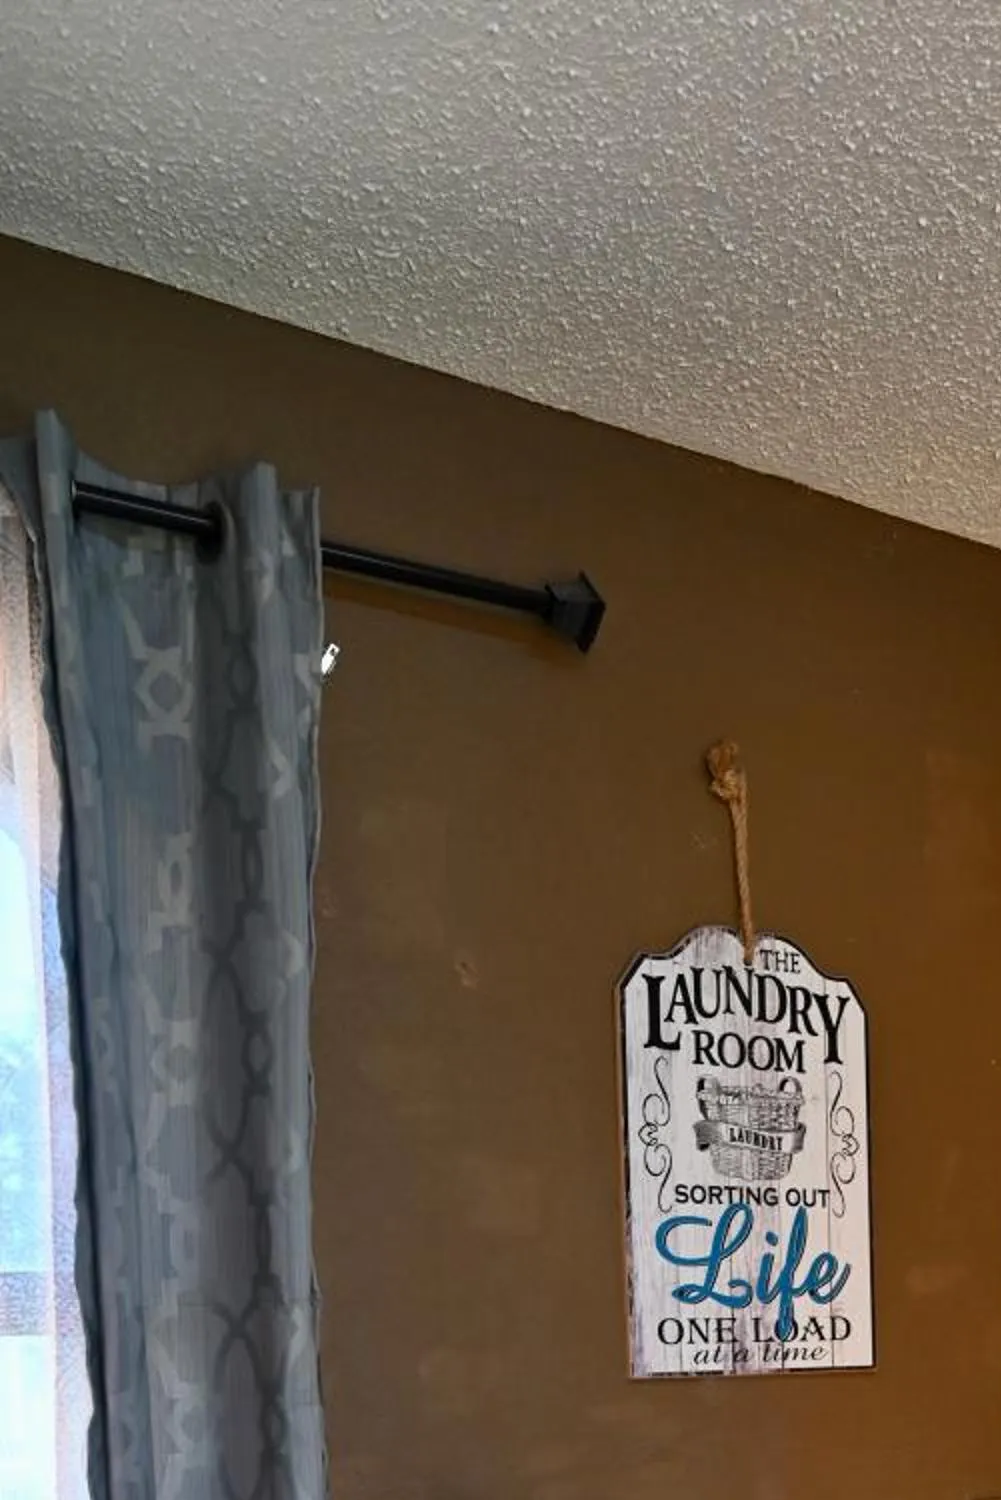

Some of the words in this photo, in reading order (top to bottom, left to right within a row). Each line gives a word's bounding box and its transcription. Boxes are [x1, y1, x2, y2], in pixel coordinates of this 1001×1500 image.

[759, 949, 801, 973] THE
[642, 966, 849, 1065] LAUNDRY
[692, 1030, 806, 1074] ROOM
[728, 1127, 783, 1150] LAUNDRY
[675, 1184, 778, 1207] SORTING
[785, 1188, 830, 1208] OUT
[655, 1203, 851, 1342] Life
[657, 1317, 738, 1345] ONE
[752, 1316, 851, 1343] LOAD
[693, 1346, 724, 1365] at
[734, 1351, 751, 1363] a
[762, 1342, 829, 1362] time
